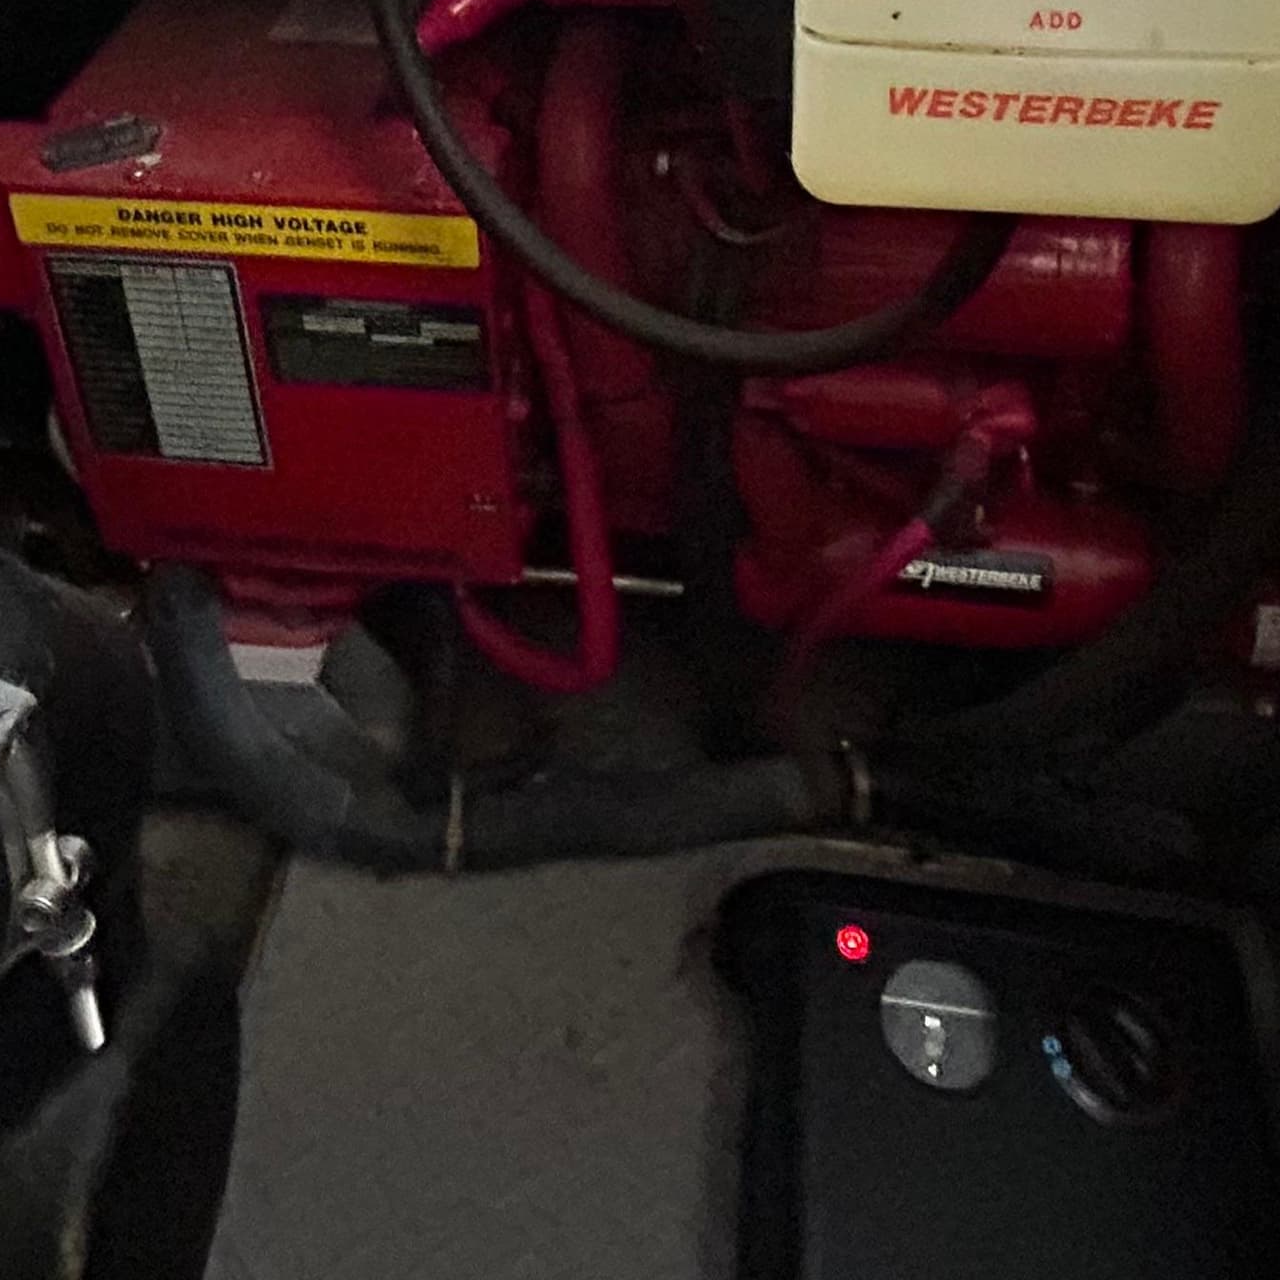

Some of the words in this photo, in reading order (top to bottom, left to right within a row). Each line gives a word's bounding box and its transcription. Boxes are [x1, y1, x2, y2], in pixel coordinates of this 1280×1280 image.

[1029, 11, 1082, 30] ADD
[888, 87, 1221, 129] WESTERBEKE
[118, 208, 202, 225] DANGER
[211, 213, 263, 229] HIGH
[273, 216, 368, 234] VOLTAGE
[46, 222, 67, 235] DO
[75, 224, 101, 236] NOT
[110, 225, 169, 240] REMOVE
[177, 229, 228, 243] COVER
[235, 232, 278, 245] WHEN
[285, 236, 343, 250] GENSET
[351, 240, 365, 251] IS
[934, 565, 1042, 592] WESTERBEKE
